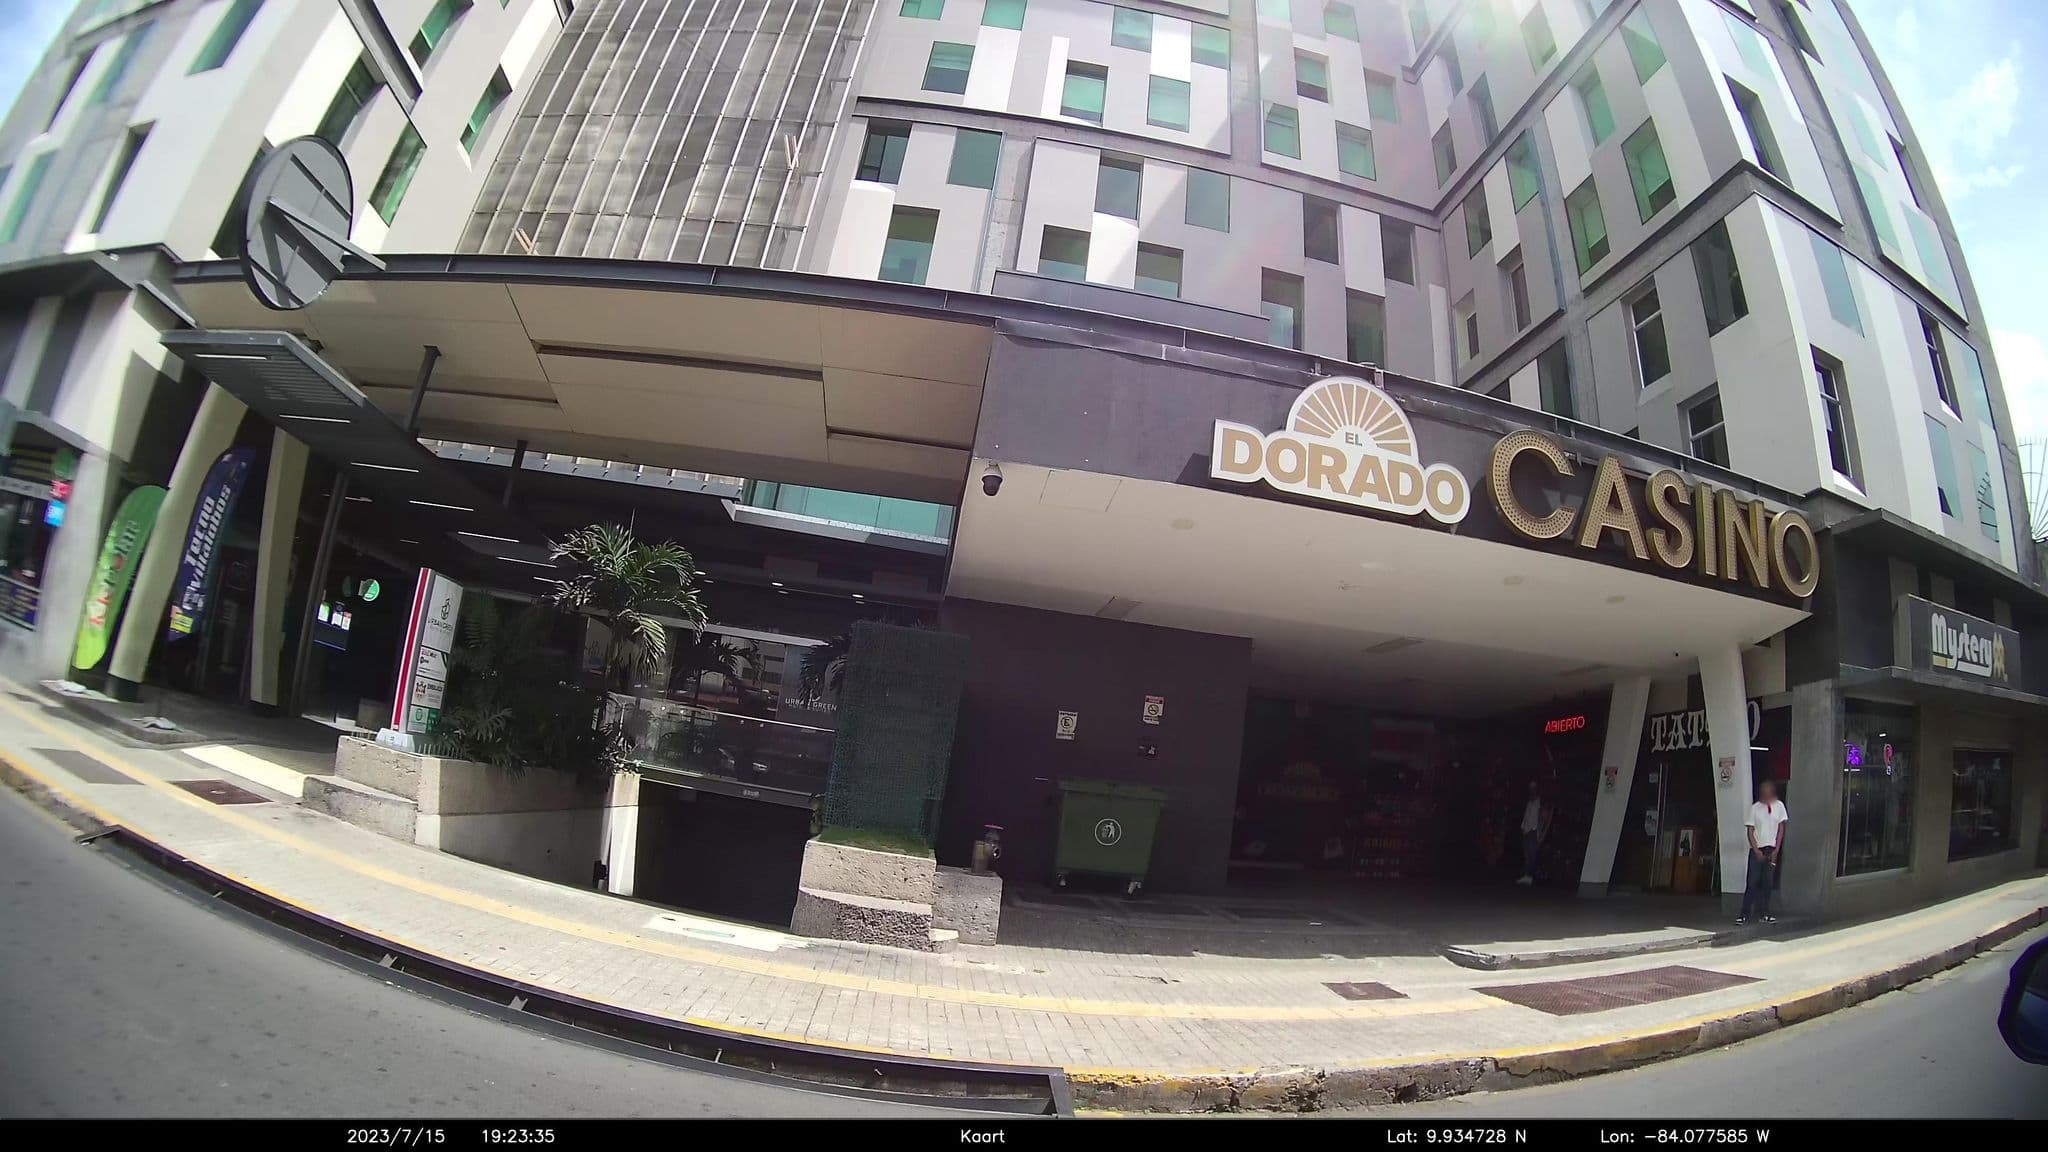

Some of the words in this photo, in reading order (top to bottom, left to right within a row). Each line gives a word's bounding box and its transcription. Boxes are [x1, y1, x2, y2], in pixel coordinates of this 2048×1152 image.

[1219, 427, 1465, 516] DORADO
[1344, 431, 1363, 446] EL
[184, 496, 215, 566] Tecno
[1487, 428, 1821, 598] CASINO
[1931, 612, 1992, 677] Mystery
[1544, 715, 1586, 734] ABIERTO
